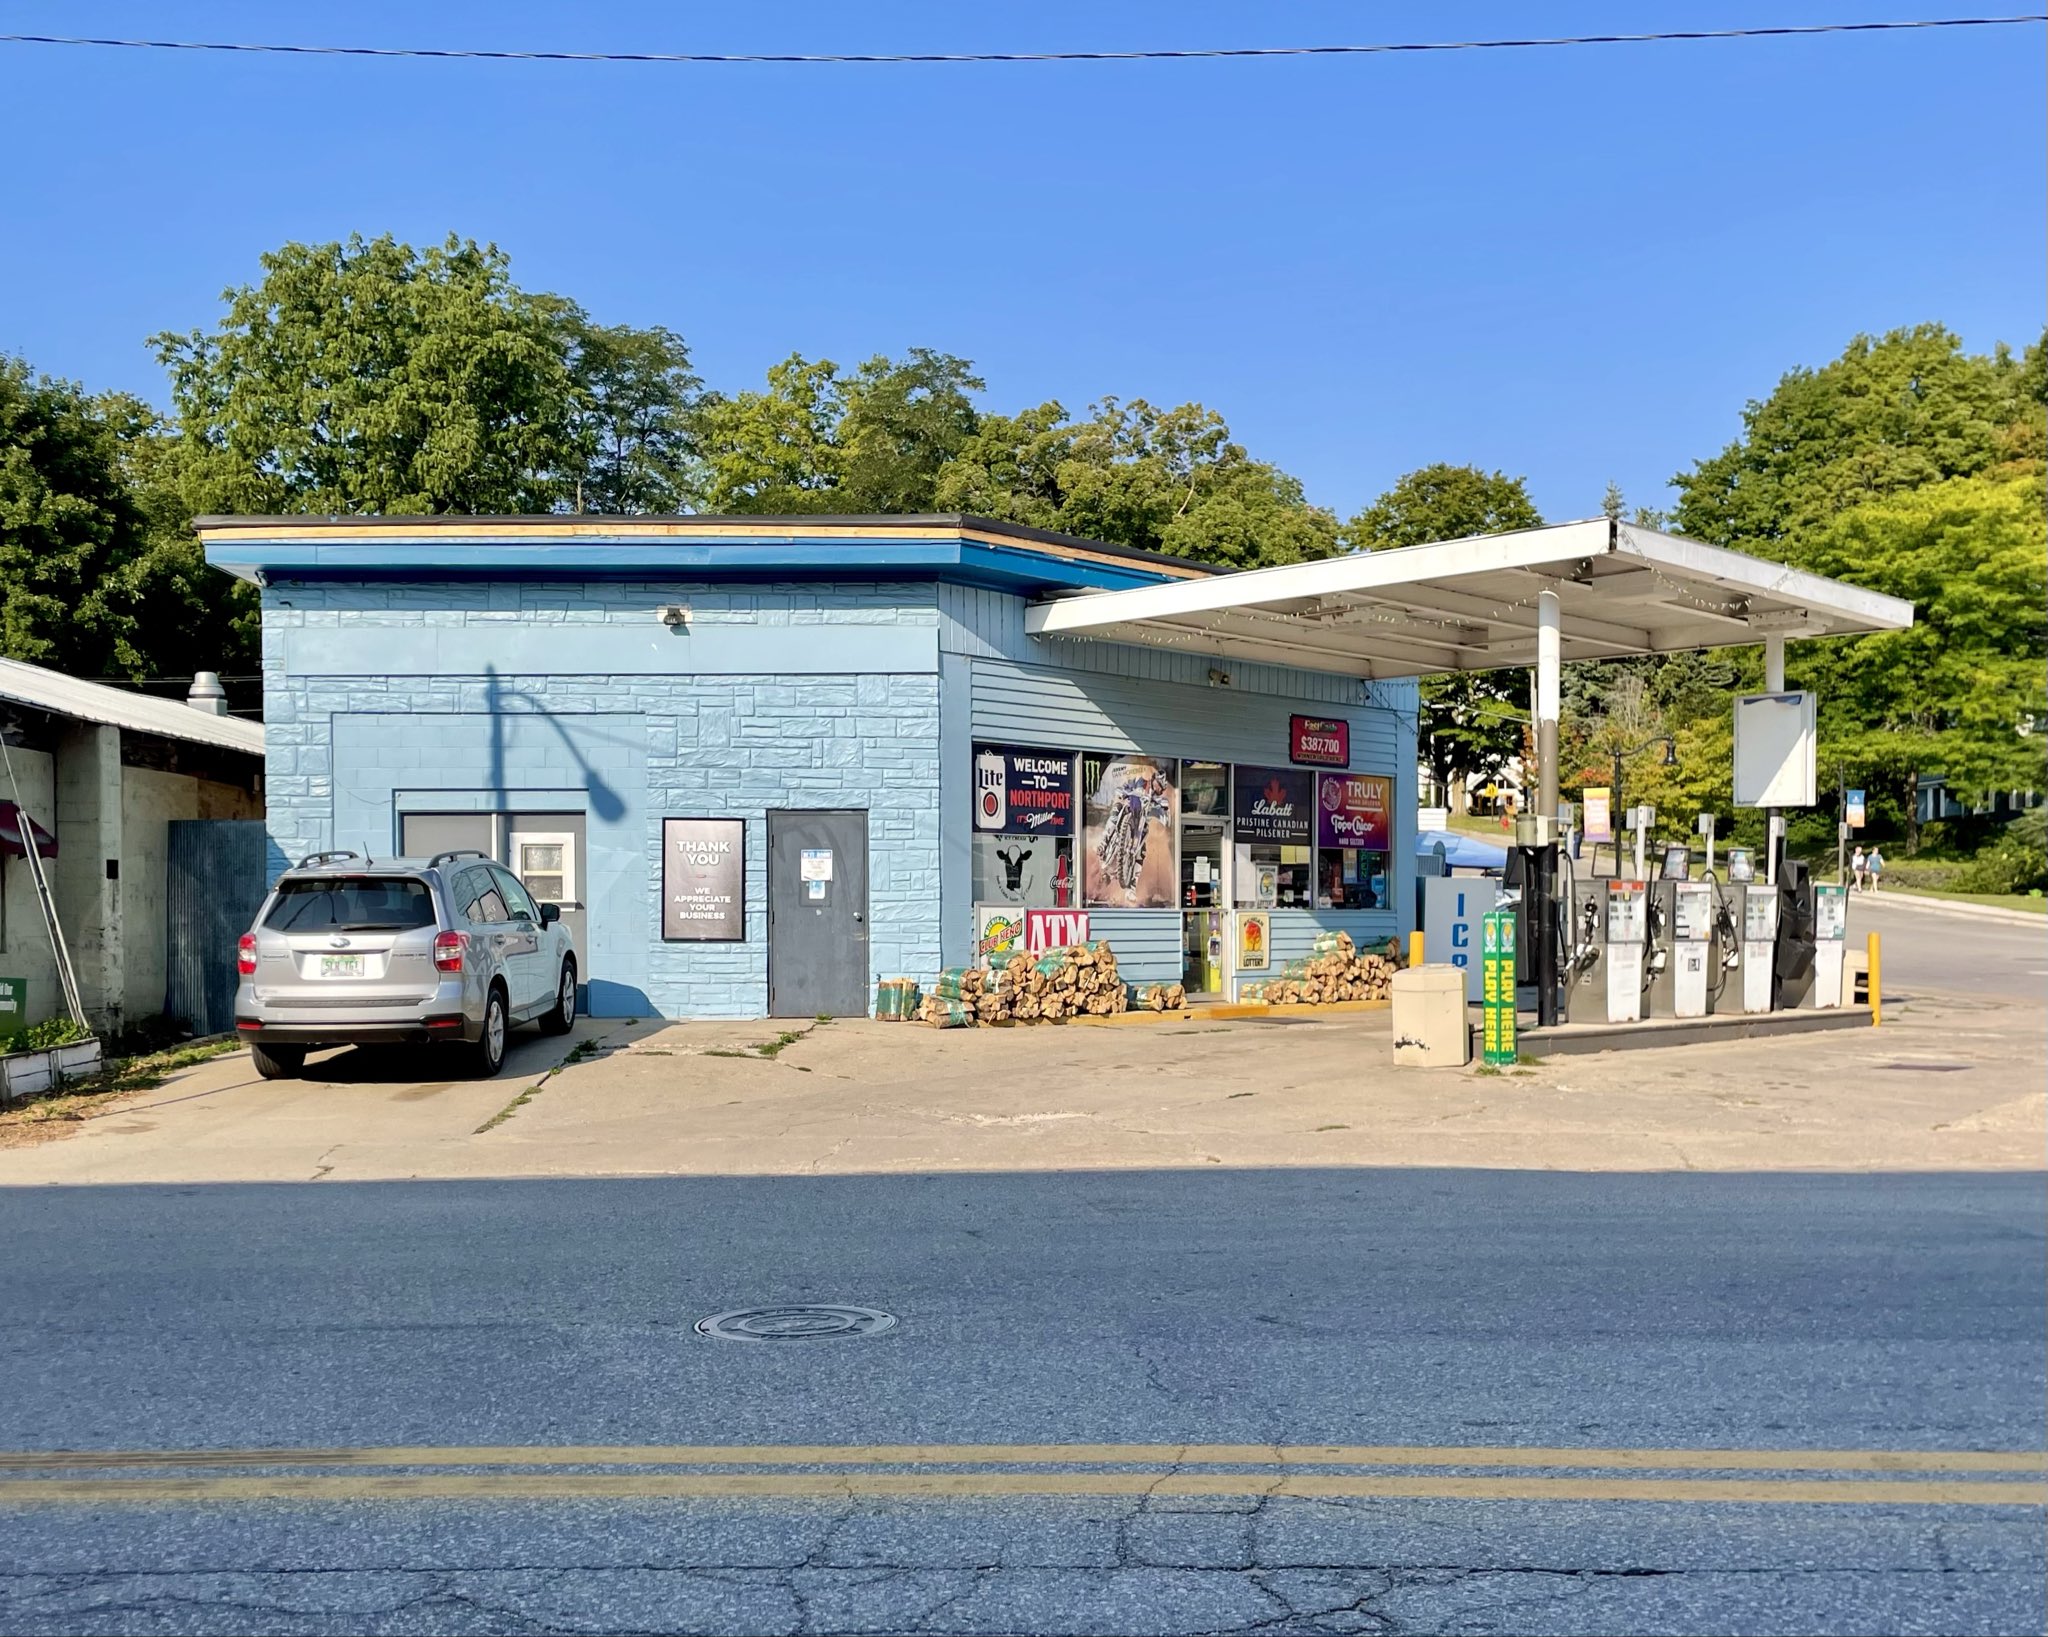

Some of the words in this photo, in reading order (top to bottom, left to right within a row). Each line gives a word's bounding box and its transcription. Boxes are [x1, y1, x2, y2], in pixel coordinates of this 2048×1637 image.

[1301, 735, 1340, 754] $387,700
[1013, 757, 1068, 775] WELCOME
[978, 768, 1003, 790] Lite
[1345, 781, 1384, 799] TRULY
[1009, 789, 1071, 810] NORTHPORT
[1251, 799, 1293, 817] Labatt
[1026, 812, 1055, 829] Miller
[1236, 816, 1270, 827] PRISTINE
[1272, 819, 1309, 829] CANADIAN
[1331, 814, 1353, 834] Topo
[1256, 828, 1290, 839] PILSENER
[676, 841, 730, 853] THANK
[687, 853, 720, 866] YOU
[674, 895, 731, 903] APPRECIATE
[694, 887, 711, 895] WE
[679, 911, 726, 920] BUSINESS
[689, 903, 716, 911] YOUR
[1000, 920, 1022, 941] KENO
[1030, 914, 1088, 960] ATM
[1243, 958, 1264, 967] LOTTERY
[1484, 960, 1497, 1003] PLAY
[1501, 960, 1514, 1003] PLAY
[1485, 1007, 1497, 1052] HERE
[1501, 1007, 1514, 1052] HERE
